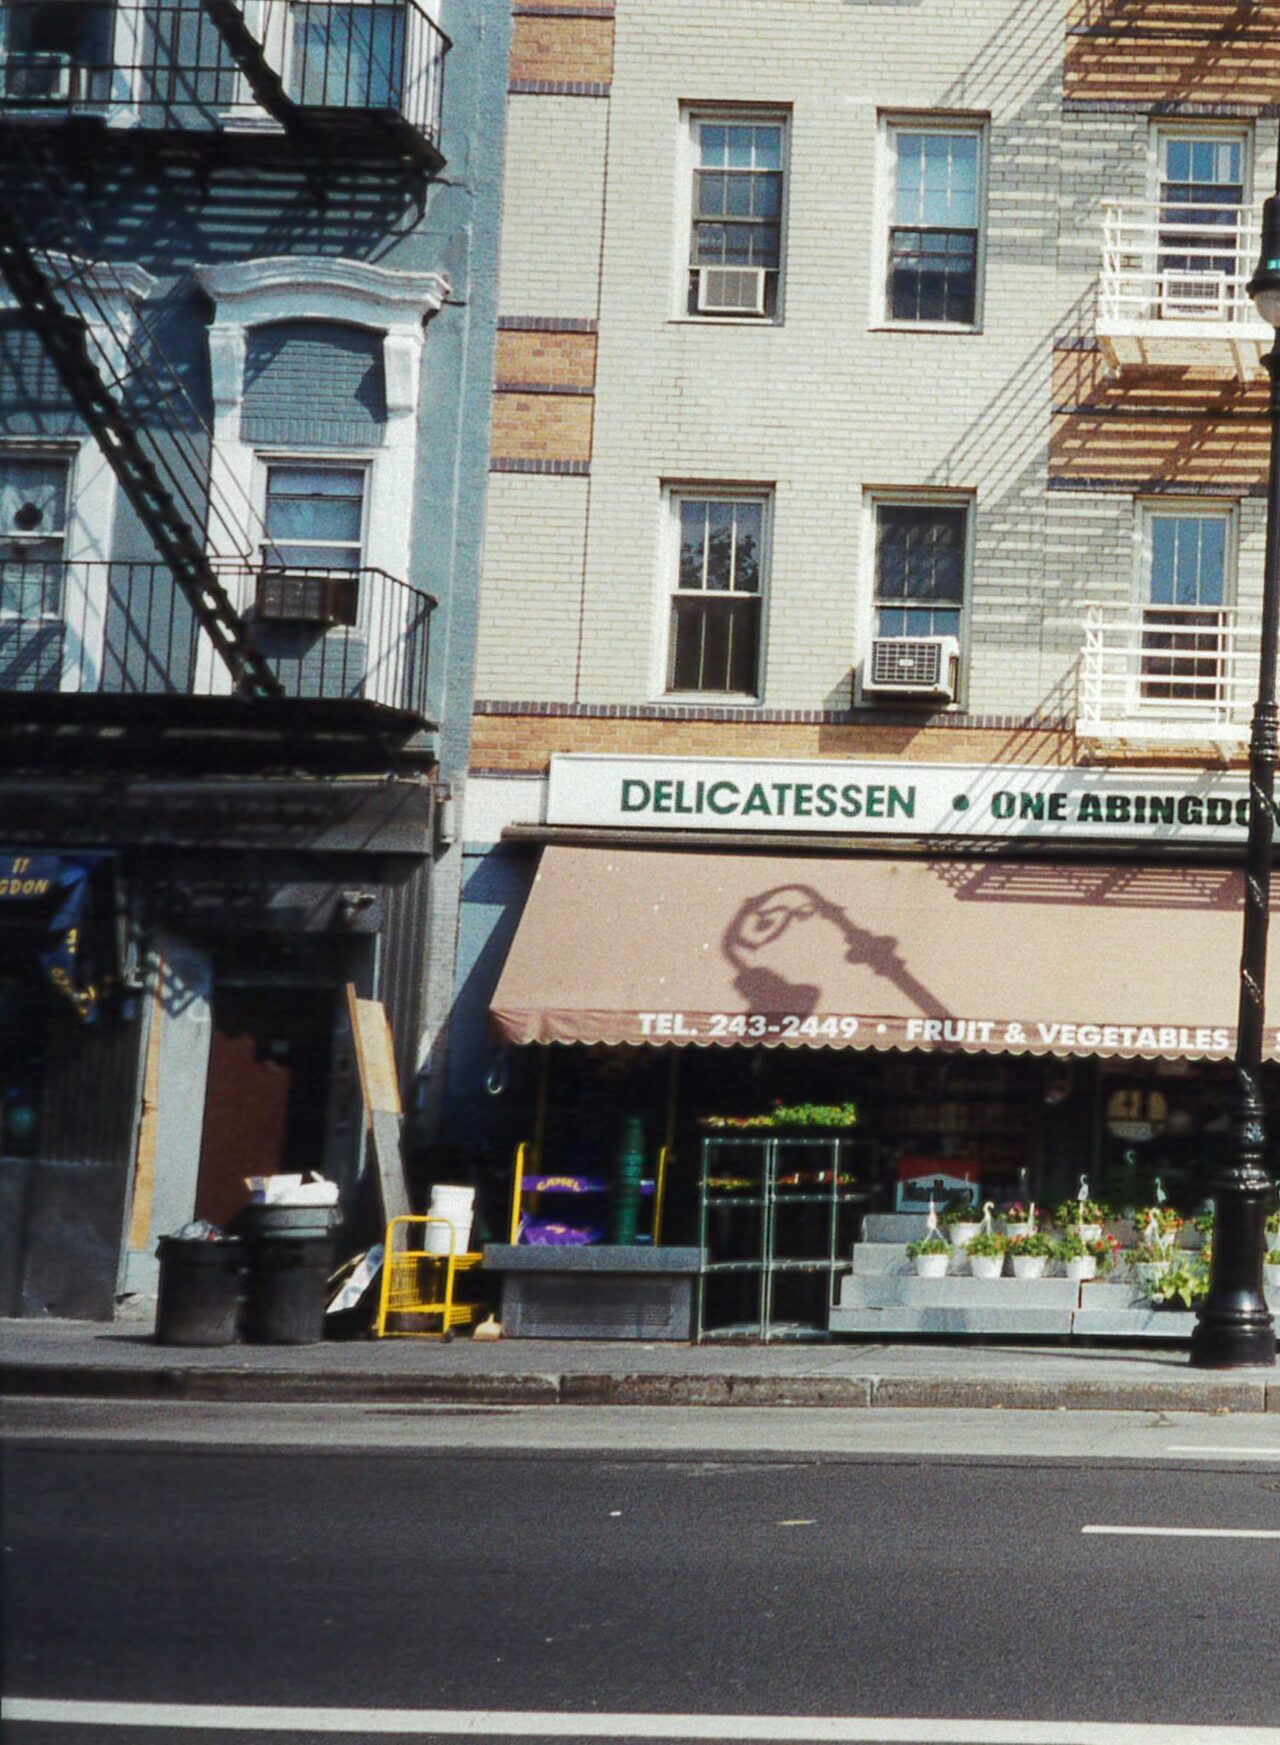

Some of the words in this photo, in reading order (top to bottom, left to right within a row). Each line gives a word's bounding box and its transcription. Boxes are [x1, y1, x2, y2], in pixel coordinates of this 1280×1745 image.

[620, 778, 917, 818] DELICATESSEN
[991, 790, 1068, 822] ONE
[637, 1012, 698, 1036] TEL.
[708, 1013, 859, 1040] 243-2449
[905, 1019, 997, 1043] FRUIT
[1003, 1023, 1027, 1044] &
[1037, 1023, 1229, 1050] VEGETABLES
[536, 1176, 582, 1192] CAMEL
